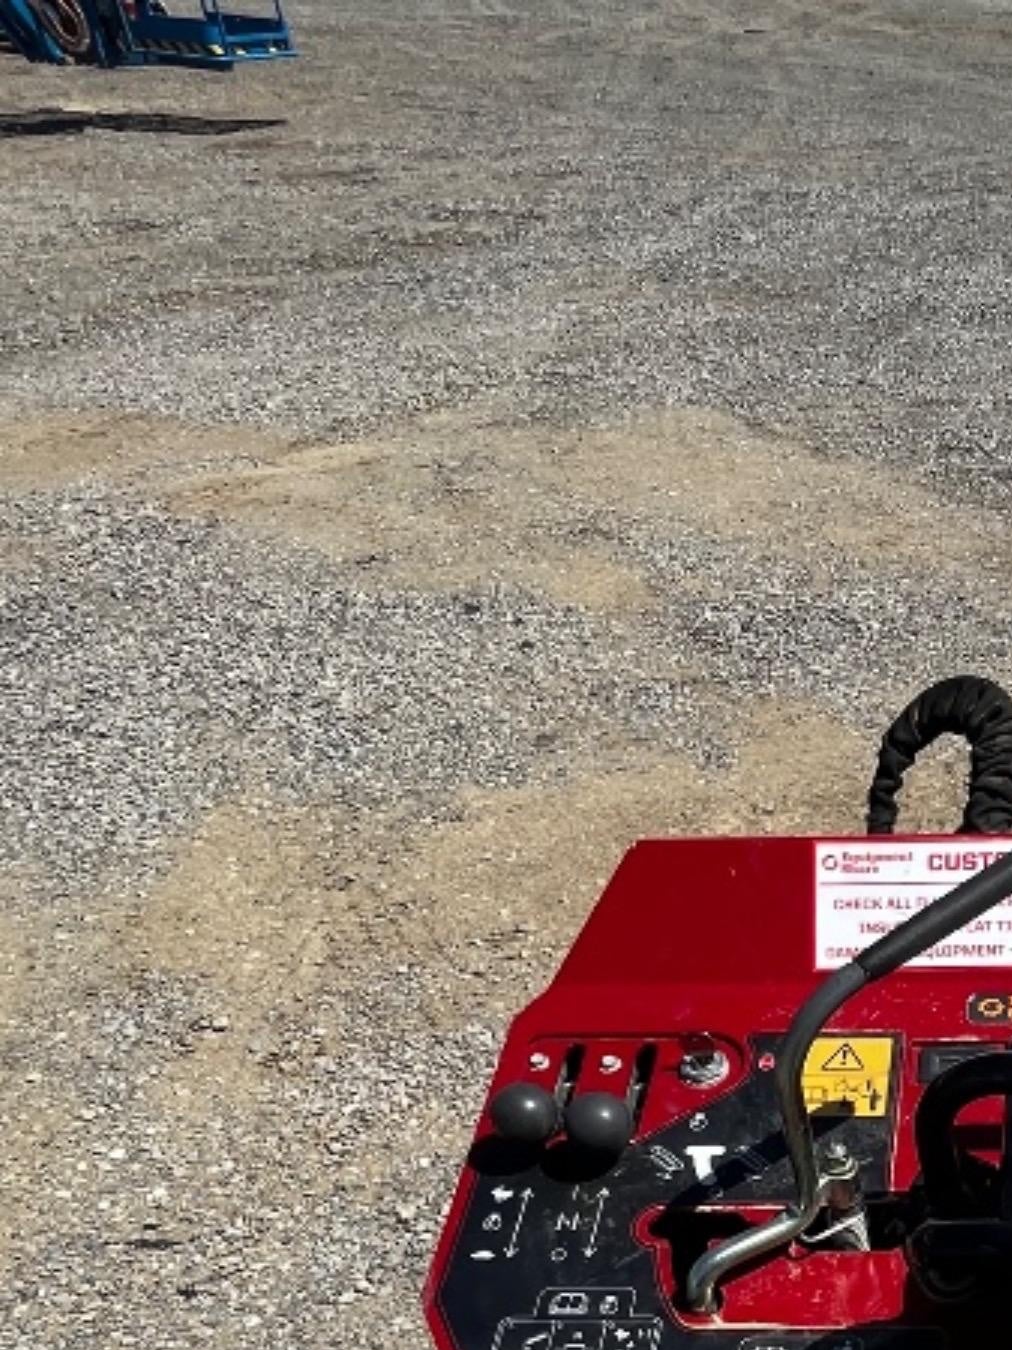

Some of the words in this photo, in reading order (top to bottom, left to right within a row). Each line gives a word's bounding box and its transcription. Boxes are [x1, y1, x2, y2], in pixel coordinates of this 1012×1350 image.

[833, 898, 882, 910] CHECK
[886, 898, 911, 909] ALL
[920, 944, 1005, 961] QUIPMENT
